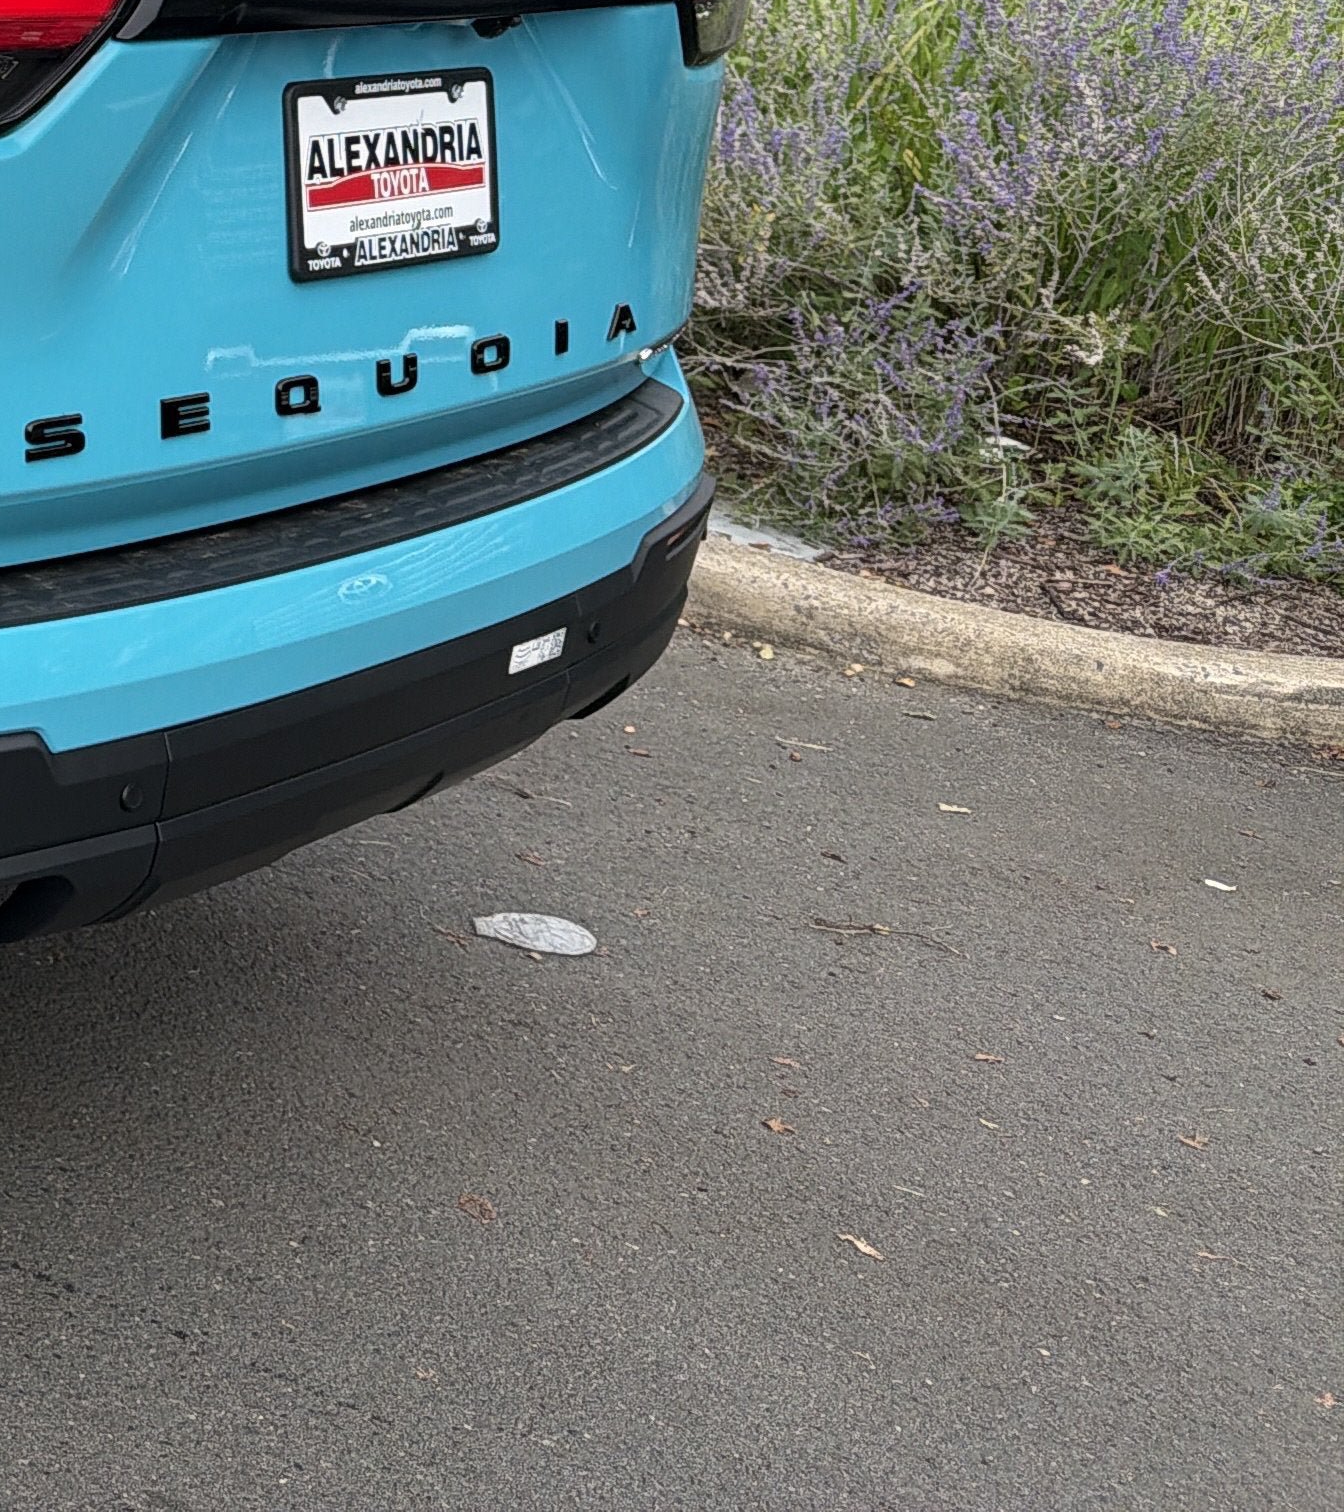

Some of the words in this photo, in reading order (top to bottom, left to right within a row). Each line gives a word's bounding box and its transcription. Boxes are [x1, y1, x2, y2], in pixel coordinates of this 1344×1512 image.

[354, 76, 442, 95] alexandriatoyota.com
[307, 121, 482, 181] ALEXANDRIA
[370, 167, 430, 199] TOYOTA
[349, 205, 454, 232] alexandriatoyota.com
[307, 256, 342, 272] TOYOTA
[355, 227, 457, 265] ALEXANDRIA
[469, 232, 497, 248] TOYOTA
[24, 301, 637, 464] SEQUOIA
